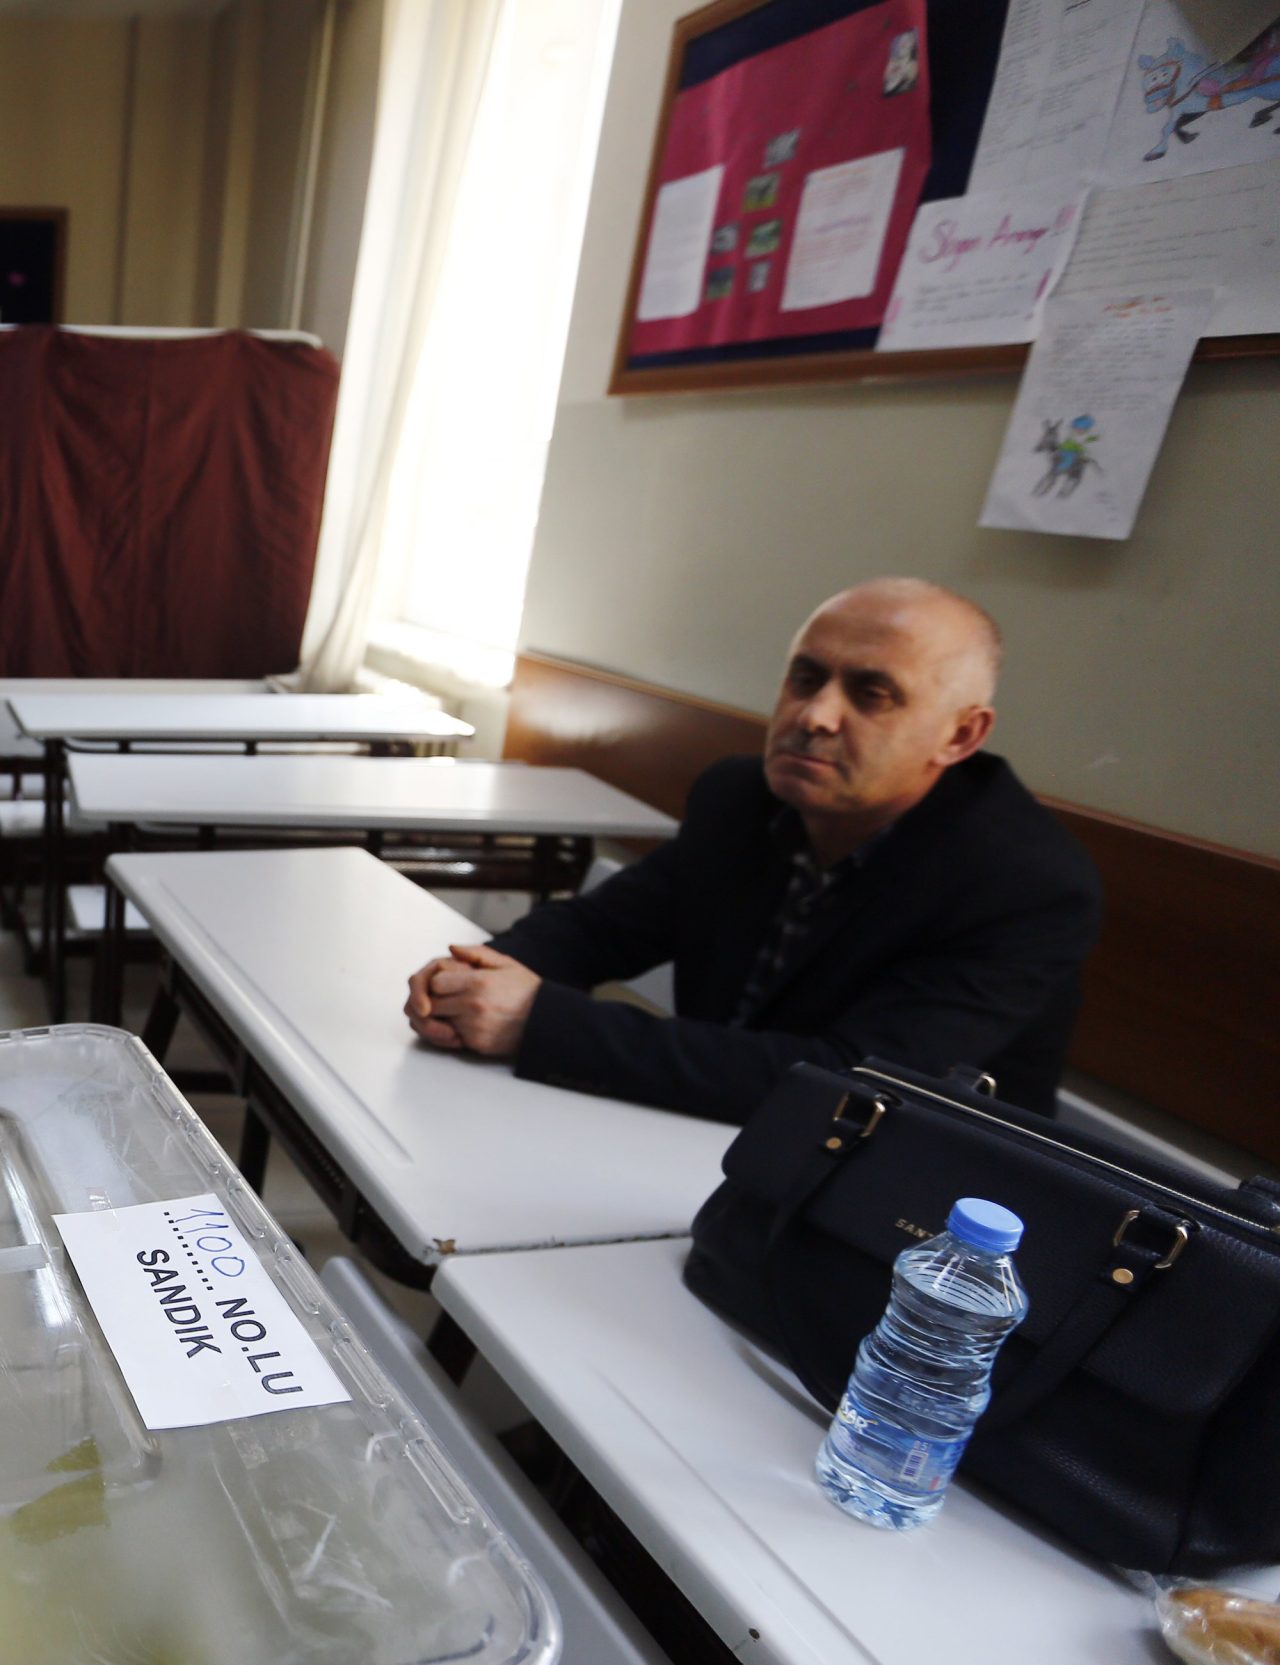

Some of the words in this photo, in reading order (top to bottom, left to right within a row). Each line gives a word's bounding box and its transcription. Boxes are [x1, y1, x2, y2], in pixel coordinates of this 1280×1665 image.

[175, 1208, 246, 1278] 1100
[136, 1249, 223, 1359] SANDIK
[215, 1297, 304, 1395] NO.LU
